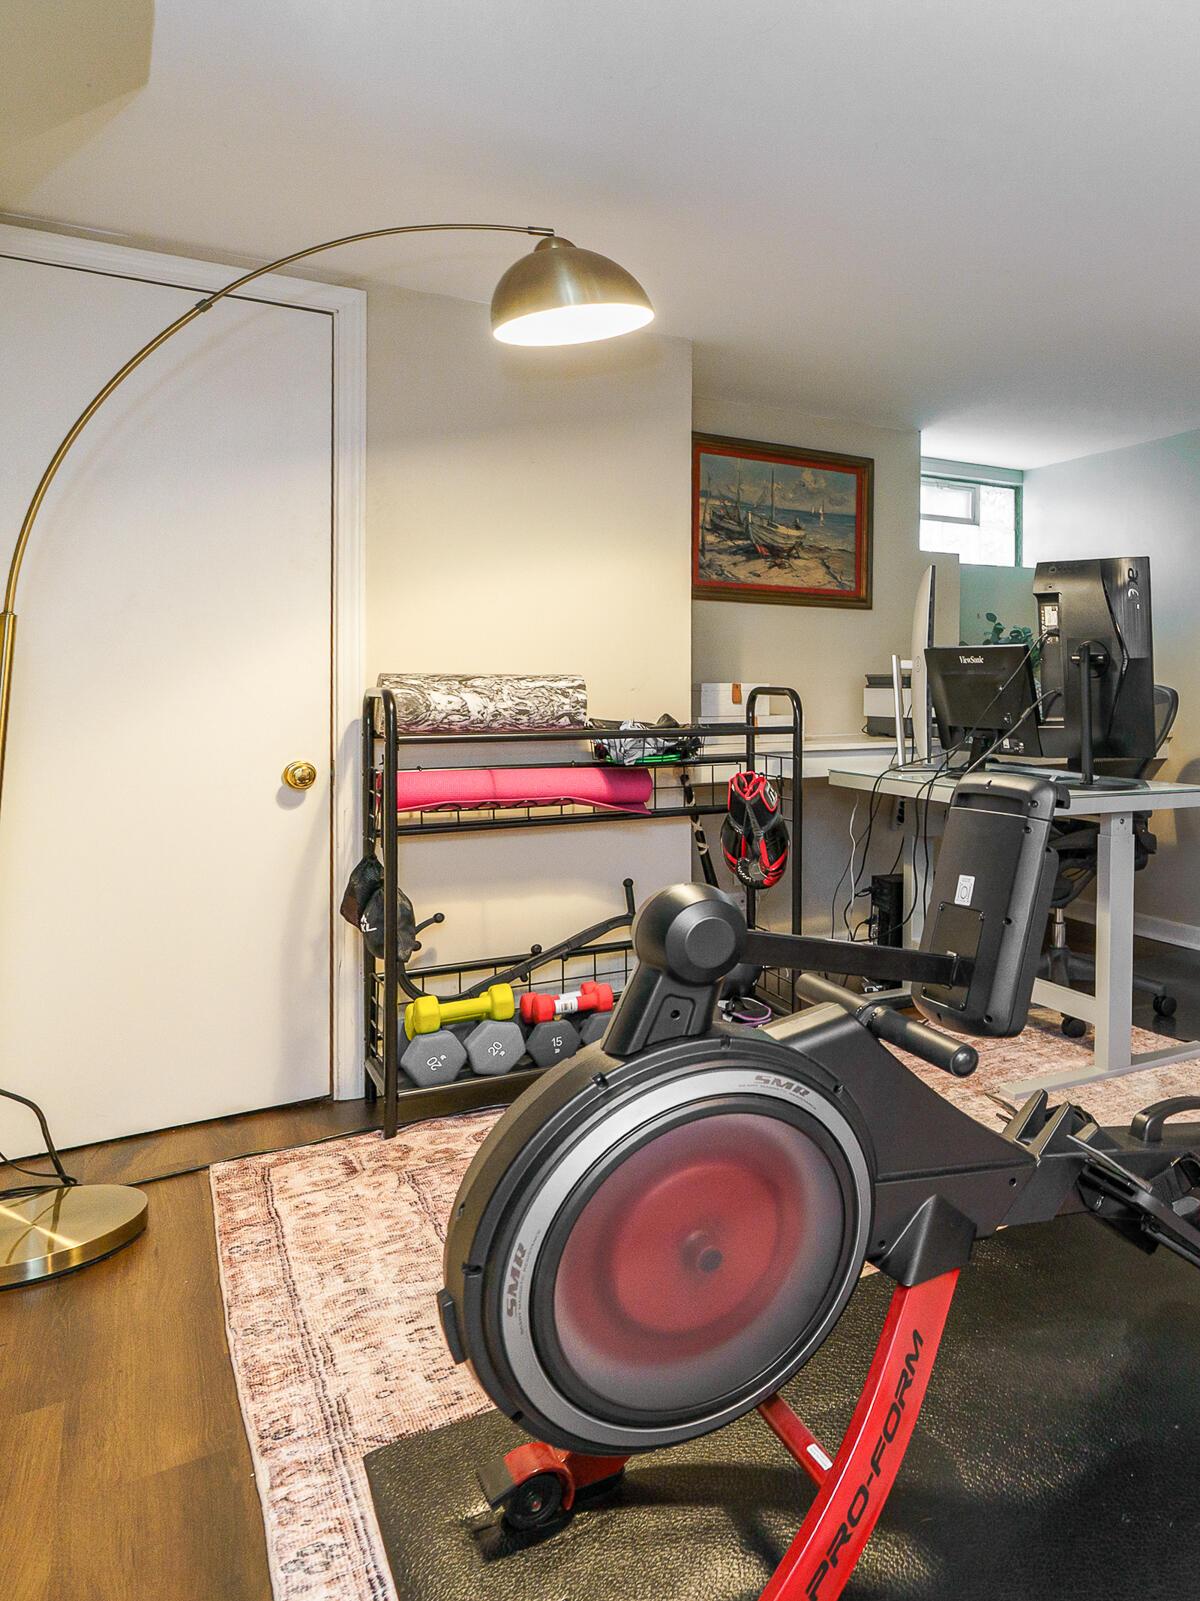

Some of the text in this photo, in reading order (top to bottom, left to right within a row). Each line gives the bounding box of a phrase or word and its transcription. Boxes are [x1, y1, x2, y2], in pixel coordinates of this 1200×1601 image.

[487, 1041, 503, 1057] 20
[551, 1036, 563, 1048] 15
[426, 1056, 442, 1071] 20
[755, 1075, 810, 1097] SMR
[506, 1242, 527, 1318] SMR
[806, 1329, 923, 1601] PRO-FORM
